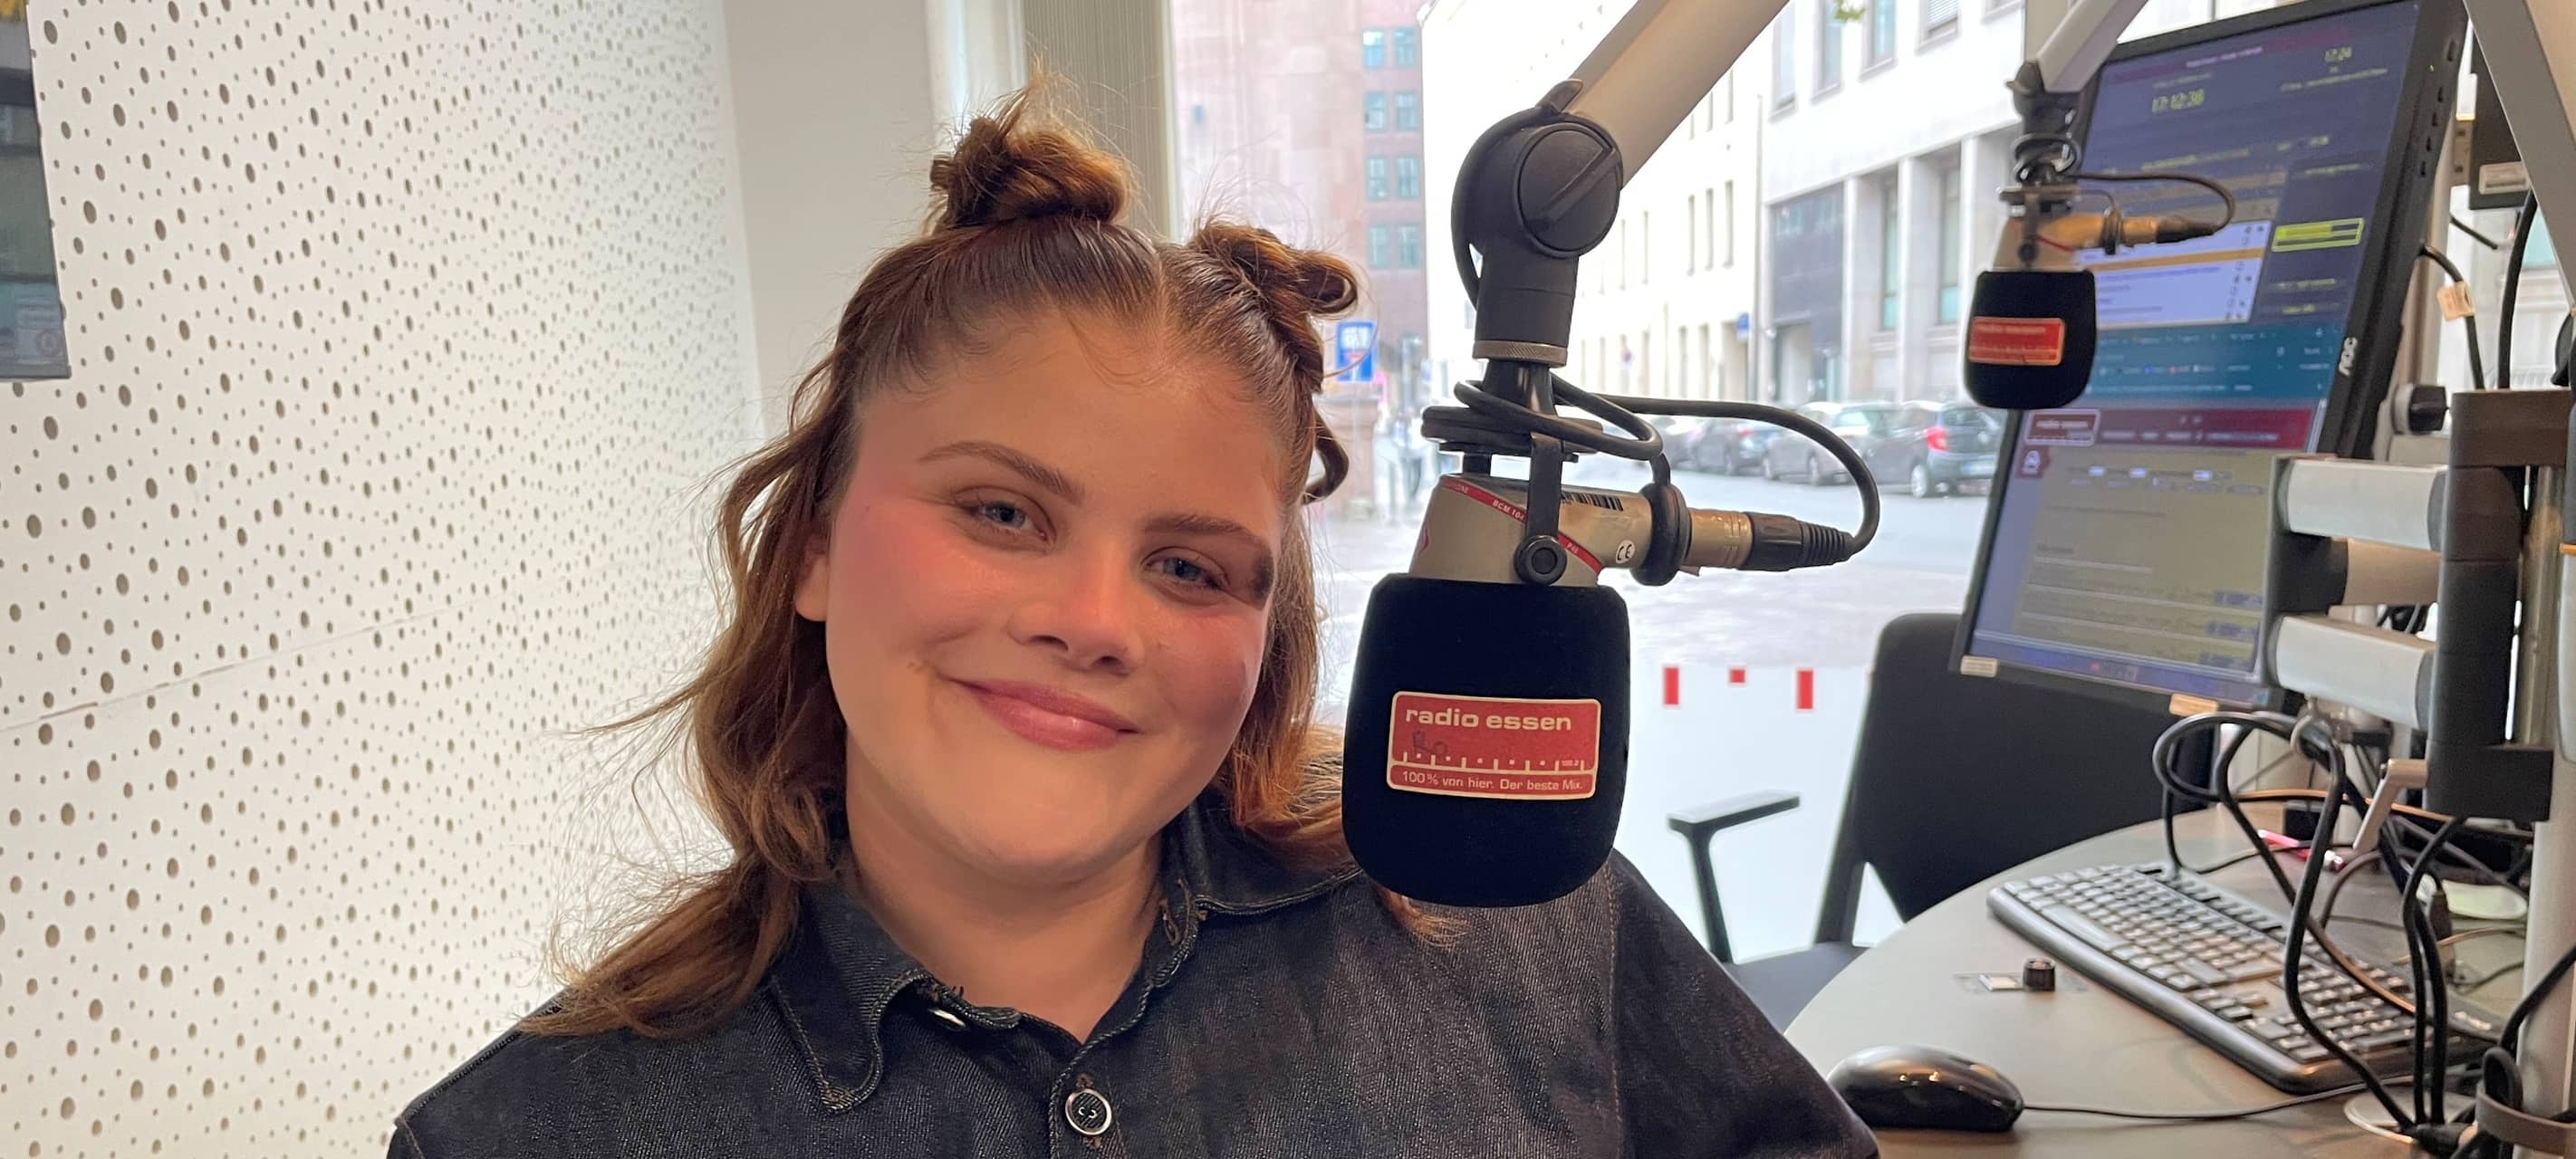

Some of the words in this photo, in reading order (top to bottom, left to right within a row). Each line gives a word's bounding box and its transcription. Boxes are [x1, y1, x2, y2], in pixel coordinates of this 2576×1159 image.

[2339, 337, 2358, 377] AOC
[1492, 500, 1510, 514] BCM
[1406, 708, 1479, 727] radio
[1485, 714, 1572, 731] essen
[1442, 778, 1464, 787] von
[1468, 777, 1494, 789] hier.
[1500, 779, 1523, 790] Der
[1527, 779, 1559, 790] beste
[1562, 780, 1583, 790] Mix.
